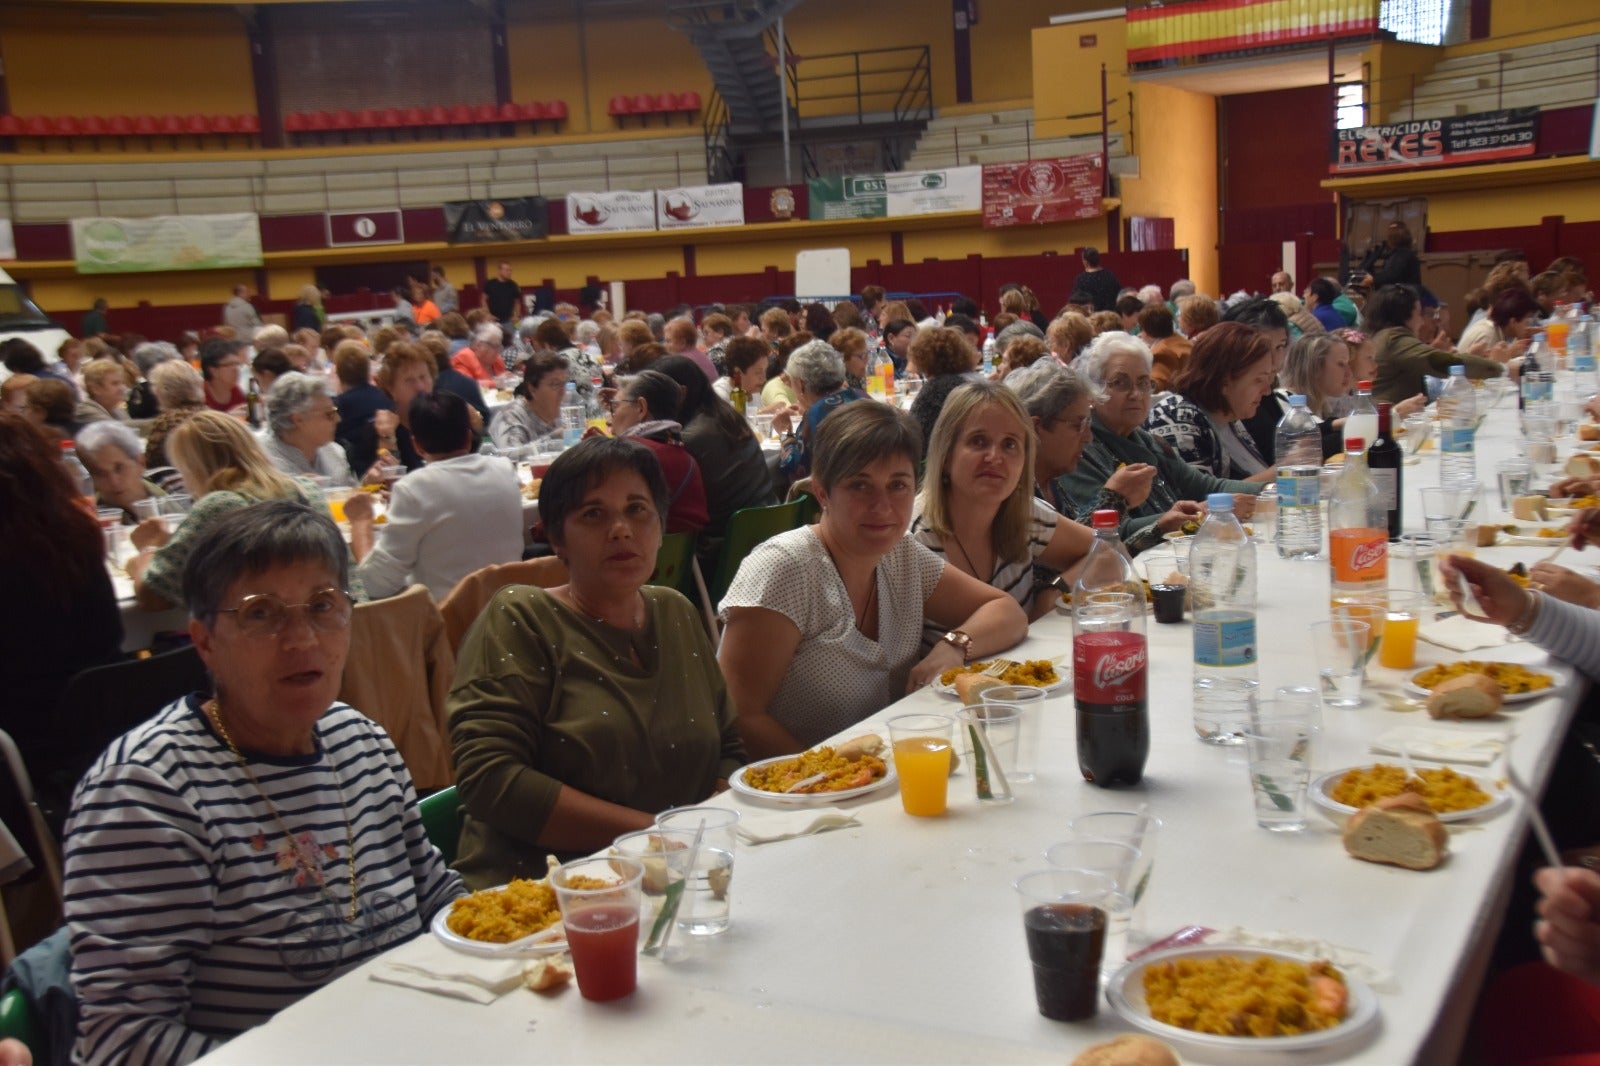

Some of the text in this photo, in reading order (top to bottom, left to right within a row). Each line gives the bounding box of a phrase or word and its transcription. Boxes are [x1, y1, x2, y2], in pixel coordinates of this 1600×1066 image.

[1501, 133, 1517, 143] 04
[1518, 131, 1533, 142] 30
[1338, 131, 1443, 164] REYES
[362, 220, 371, 235] 1
